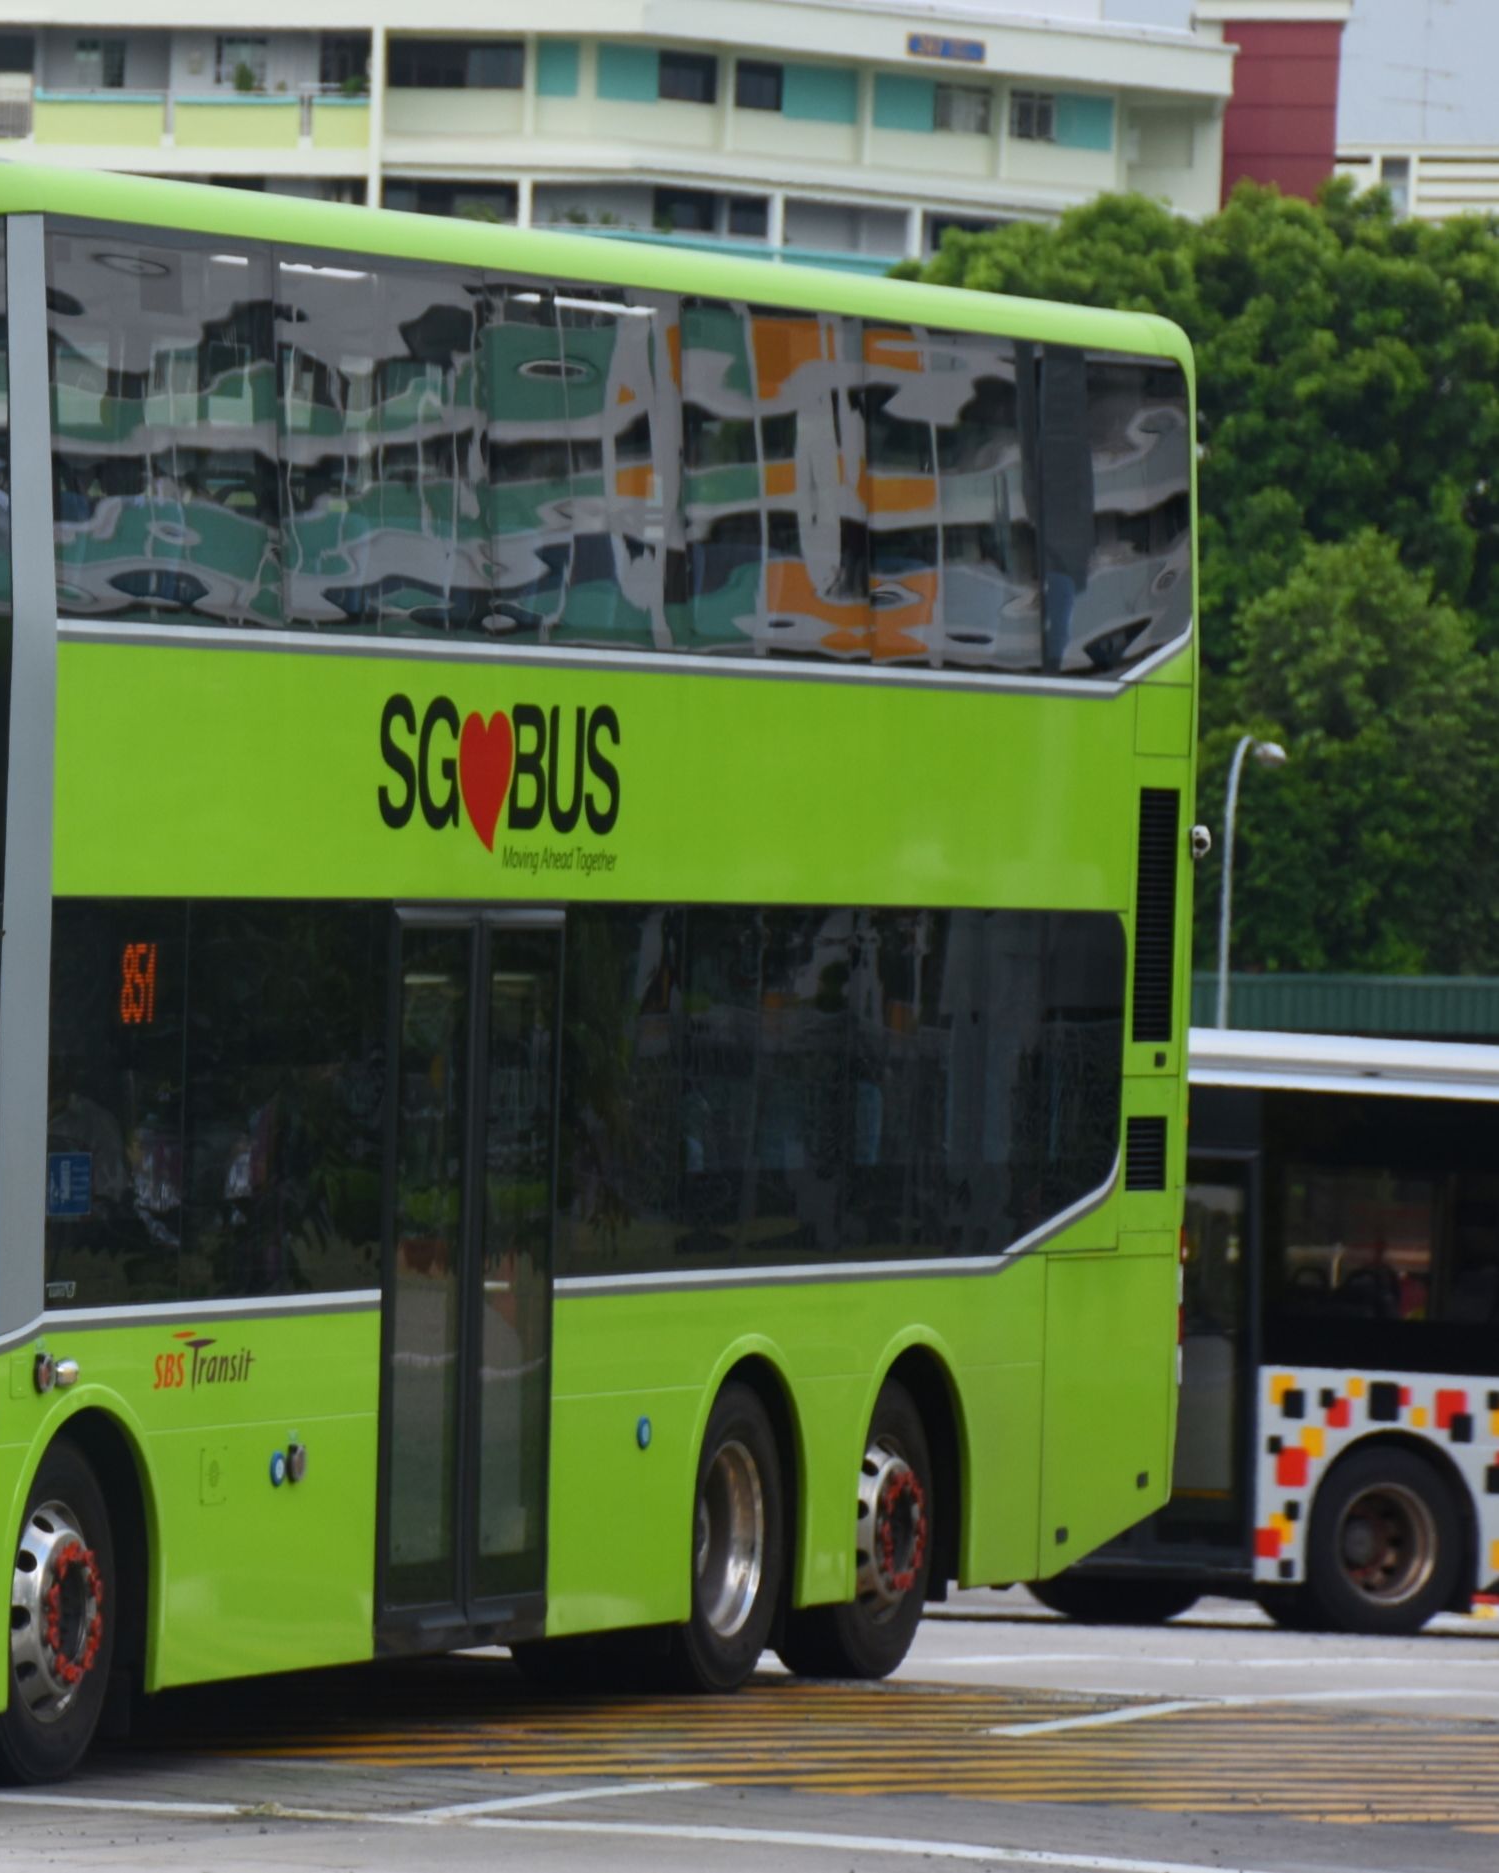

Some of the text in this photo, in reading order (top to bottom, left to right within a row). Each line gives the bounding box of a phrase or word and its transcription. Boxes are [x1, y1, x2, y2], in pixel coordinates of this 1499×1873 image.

[502, 845, 618, 877] Moving Ahead Together
[121, 943, 158, 1024] 851
[153, 1338, 256, 1393] SBS Transit
